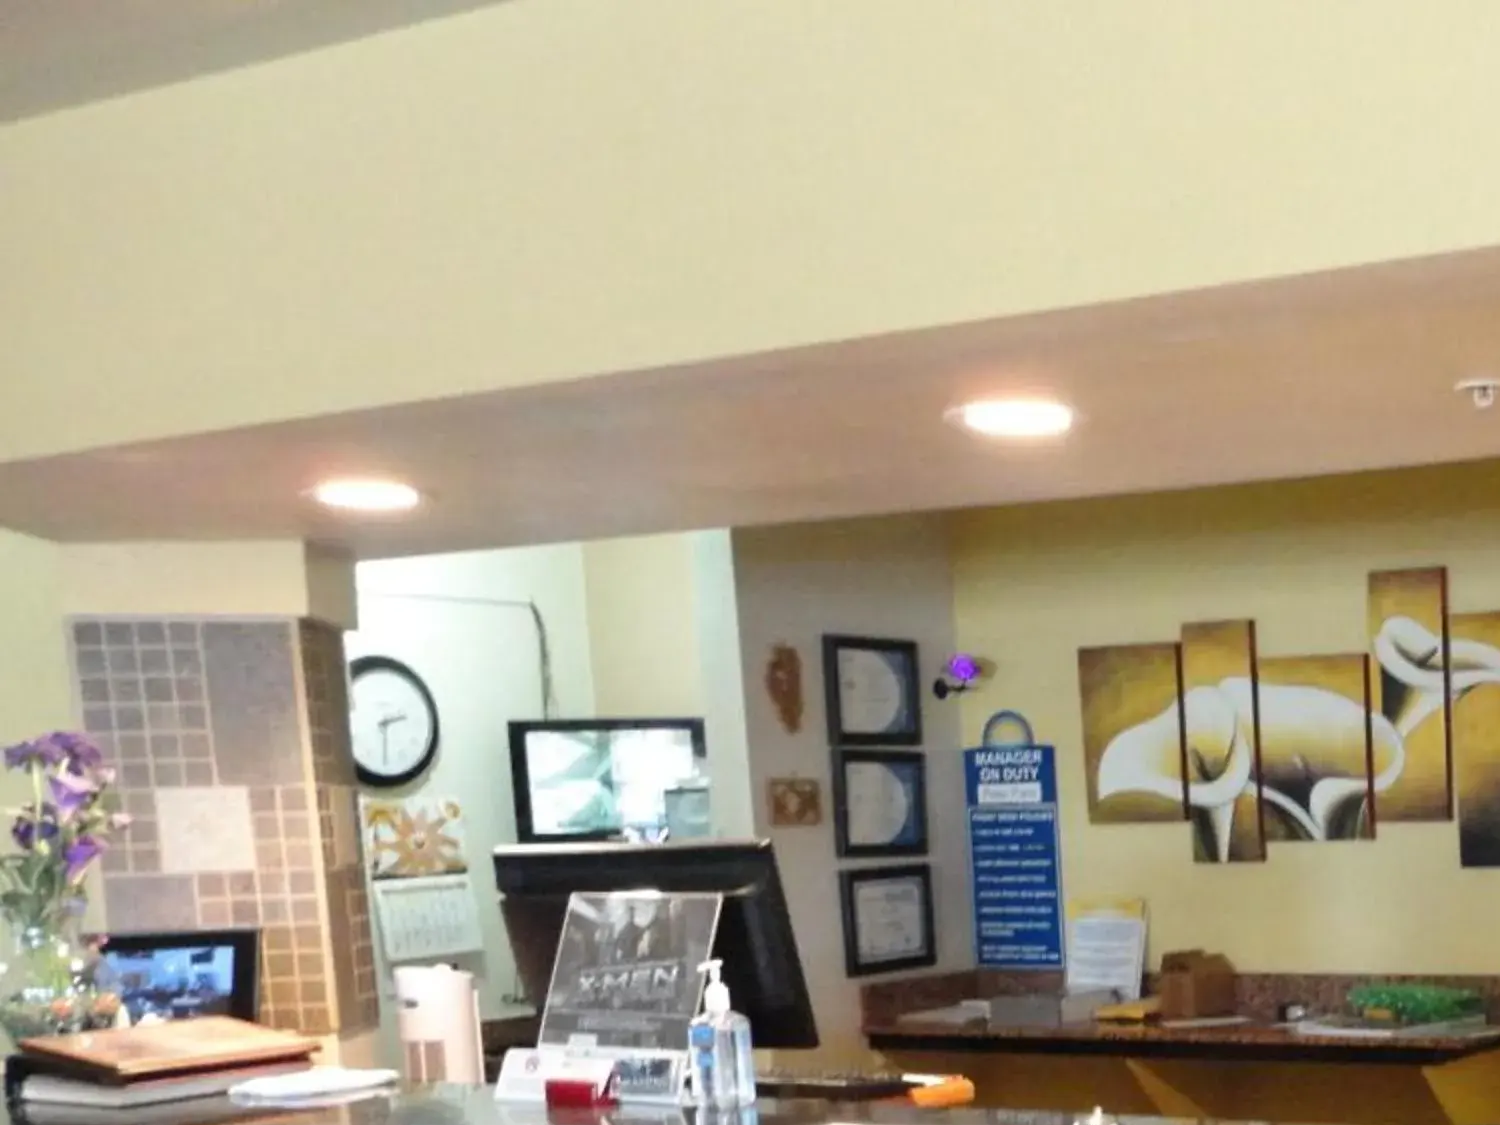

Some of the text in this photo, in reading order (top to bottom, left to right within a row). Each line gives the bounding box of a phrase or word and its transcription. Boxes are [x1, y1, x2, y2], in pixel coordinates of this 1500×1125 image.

[975, 750, 1042, 767] MANAGER
[980, 767, 1038, 780] ON DUTY
